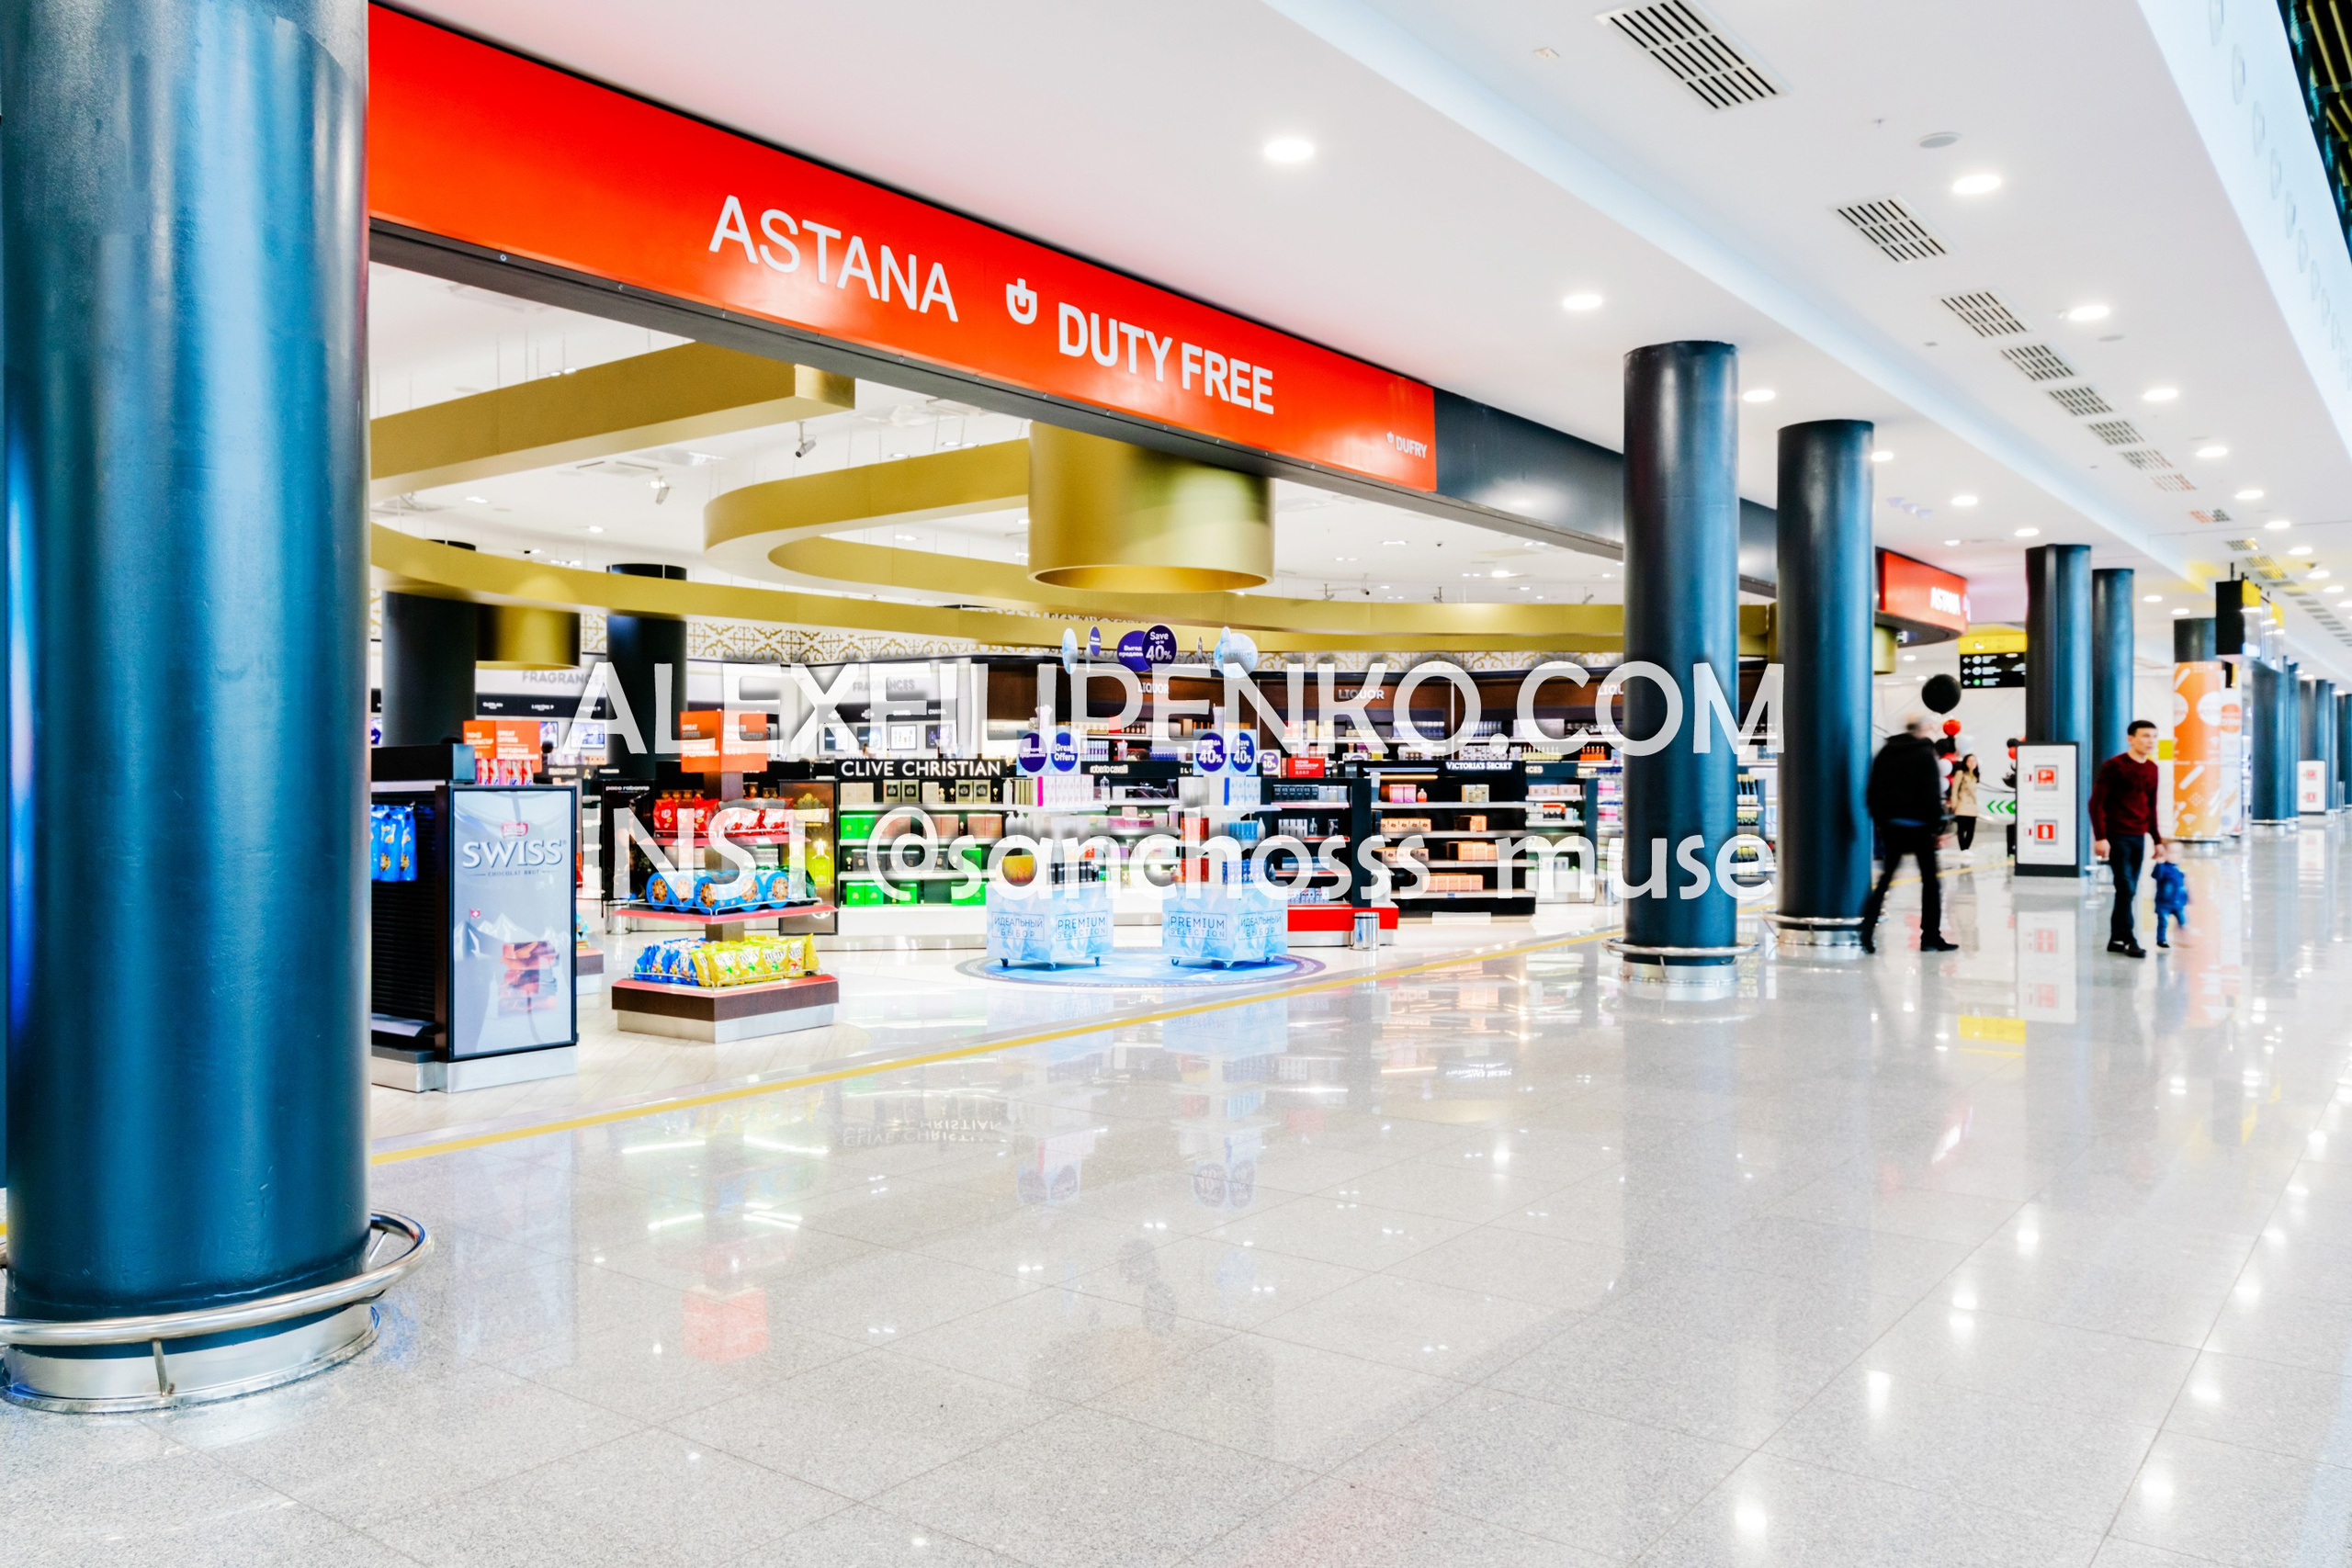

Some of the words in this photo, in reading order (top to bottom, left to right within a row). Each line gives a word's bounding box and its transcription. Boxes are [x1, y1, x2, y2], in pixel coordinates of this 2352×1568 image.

[708, 195, 958, 322] ASTANA
[1058, 301, 1172, 382] DUTY
[1182, 342, 1274, 414] FREE
[1396, 435, 1428, 458] DUFRY
[1149, 631, 1169, 640] Save
[1146, 645, 1172, 661] 40%
[1137, 682, 1170, 694] LIQUOR
[1597, 684, 1623, 695] LIQU
[1338, 689, 1385, 700] LIQUOR
[1056, 743, 1074, 751] Great
[1237, 739, 1250, 747] Save
[1054, 752, 1075, 761] Offers
[1198, 750, 1224, 764] 40%
[1233, 750, 1252, 764] 40%
[841, 761, 895, 776] CLIVE
[901, 761, 1001, 776] CHRISTIAN
[1446, 761, 1485, 771] VICTORIA'S
[1487, 761, 1513, 771] SECRET
[462, 839, 563, 868] SWISS
[994, 916, 1043, 929] ИДЕАЛЬНЫЙ
[1057, 917, 1106, 930] PREMIUM
[1170, 916, 1225, 930] PREMIUM
[1240, 913, 1282, 928] ИДЕАЛЬНЫЙ
[1001, 929, 1035, 939] ВЫБОР
[1057, 927, 1106, 939] SELECTION
[1170, 927, 1225, 938] SELECTION
[1246, 927, 1275, 938] ВЫБОР
